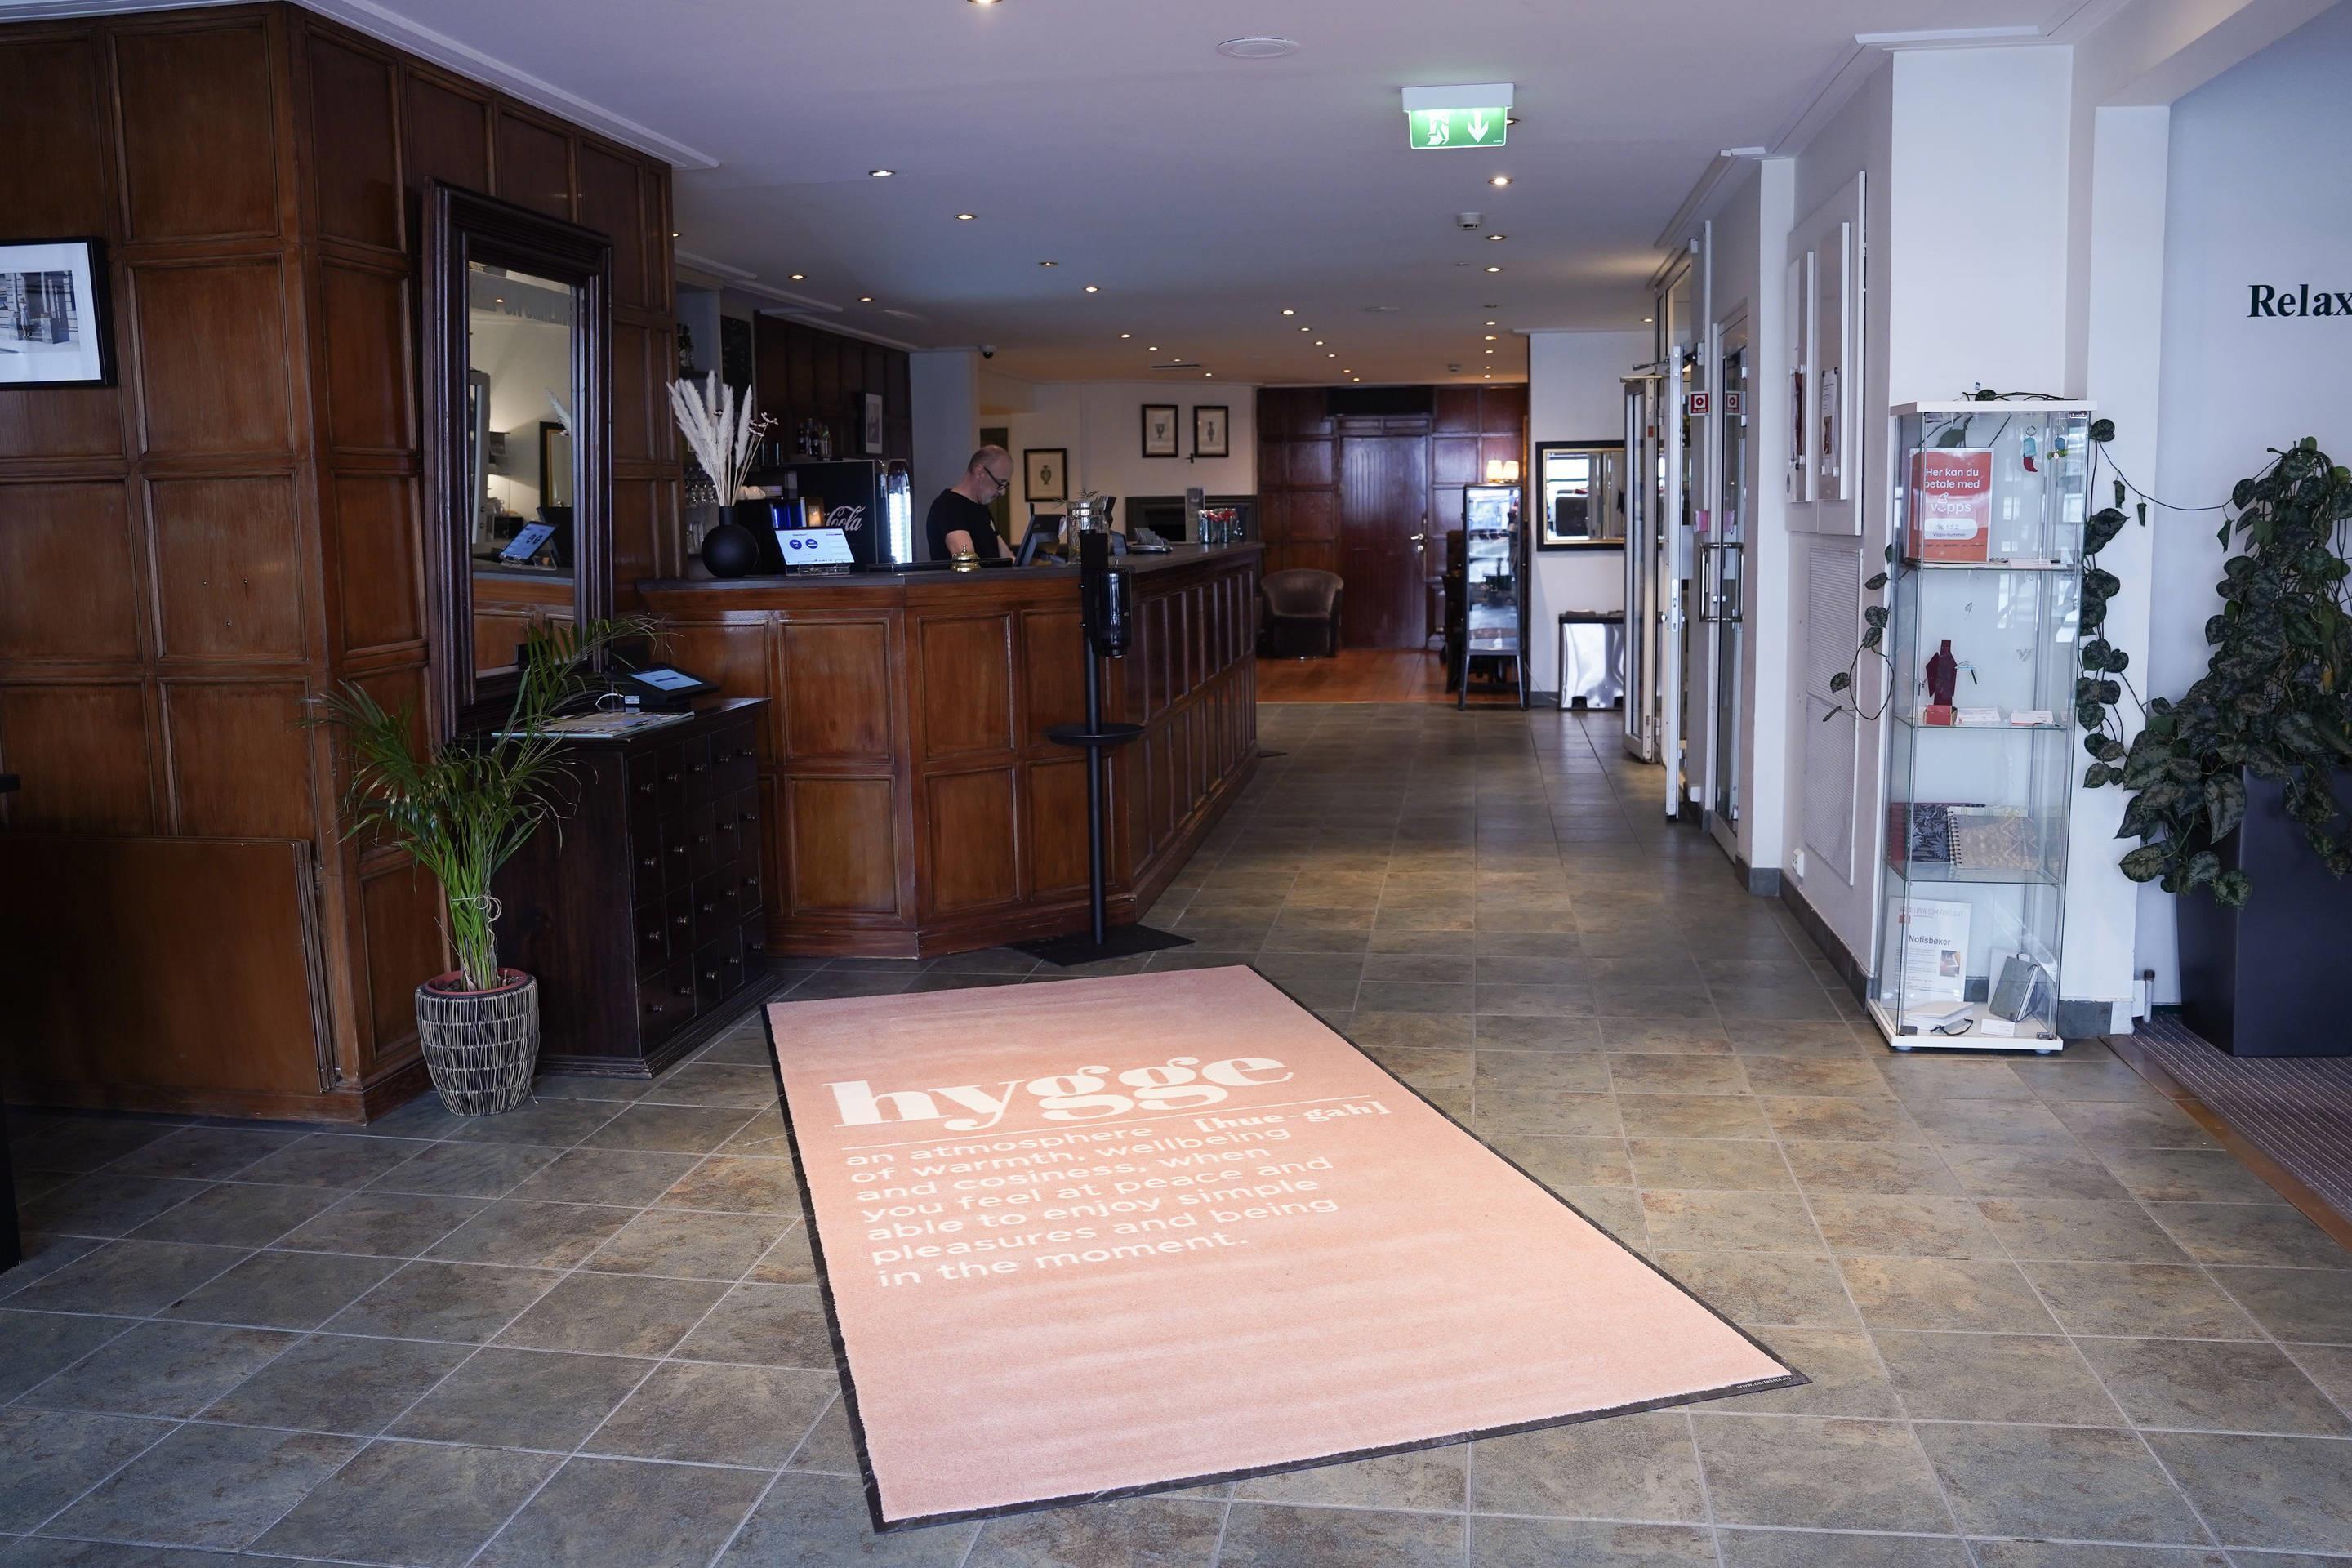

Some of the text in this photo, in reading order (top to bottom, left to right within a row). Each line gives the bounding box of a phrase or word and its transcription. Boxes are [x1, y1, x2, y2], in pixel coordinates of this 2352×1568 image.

[2247, 283, 2352, 318] Relax
[1926, 468, 1979, 477] Her kan du
[1958, 479, 1980, 488] med
[1909, 934, 1951, 946] Notisbøker
[822, 1057, 1294, 1131] hygge
[1193, 1100, 1391, 1134] [hue-gah]
[846, 1127, 1153, 1166] an atmosphere
[851, 1128, 1290, 1183] of warmth, wellbeing
[857, 1147, 1272, 1200] and cosiness, when
[862, 1156, 1334, 1223] you feel at peace and
[868, 1179, 1320, 1241] able to enjoy simple
[871, 1199, 1339, 1266] pleasures and being
[878, 1232, 1249, 1288] in the moment.
